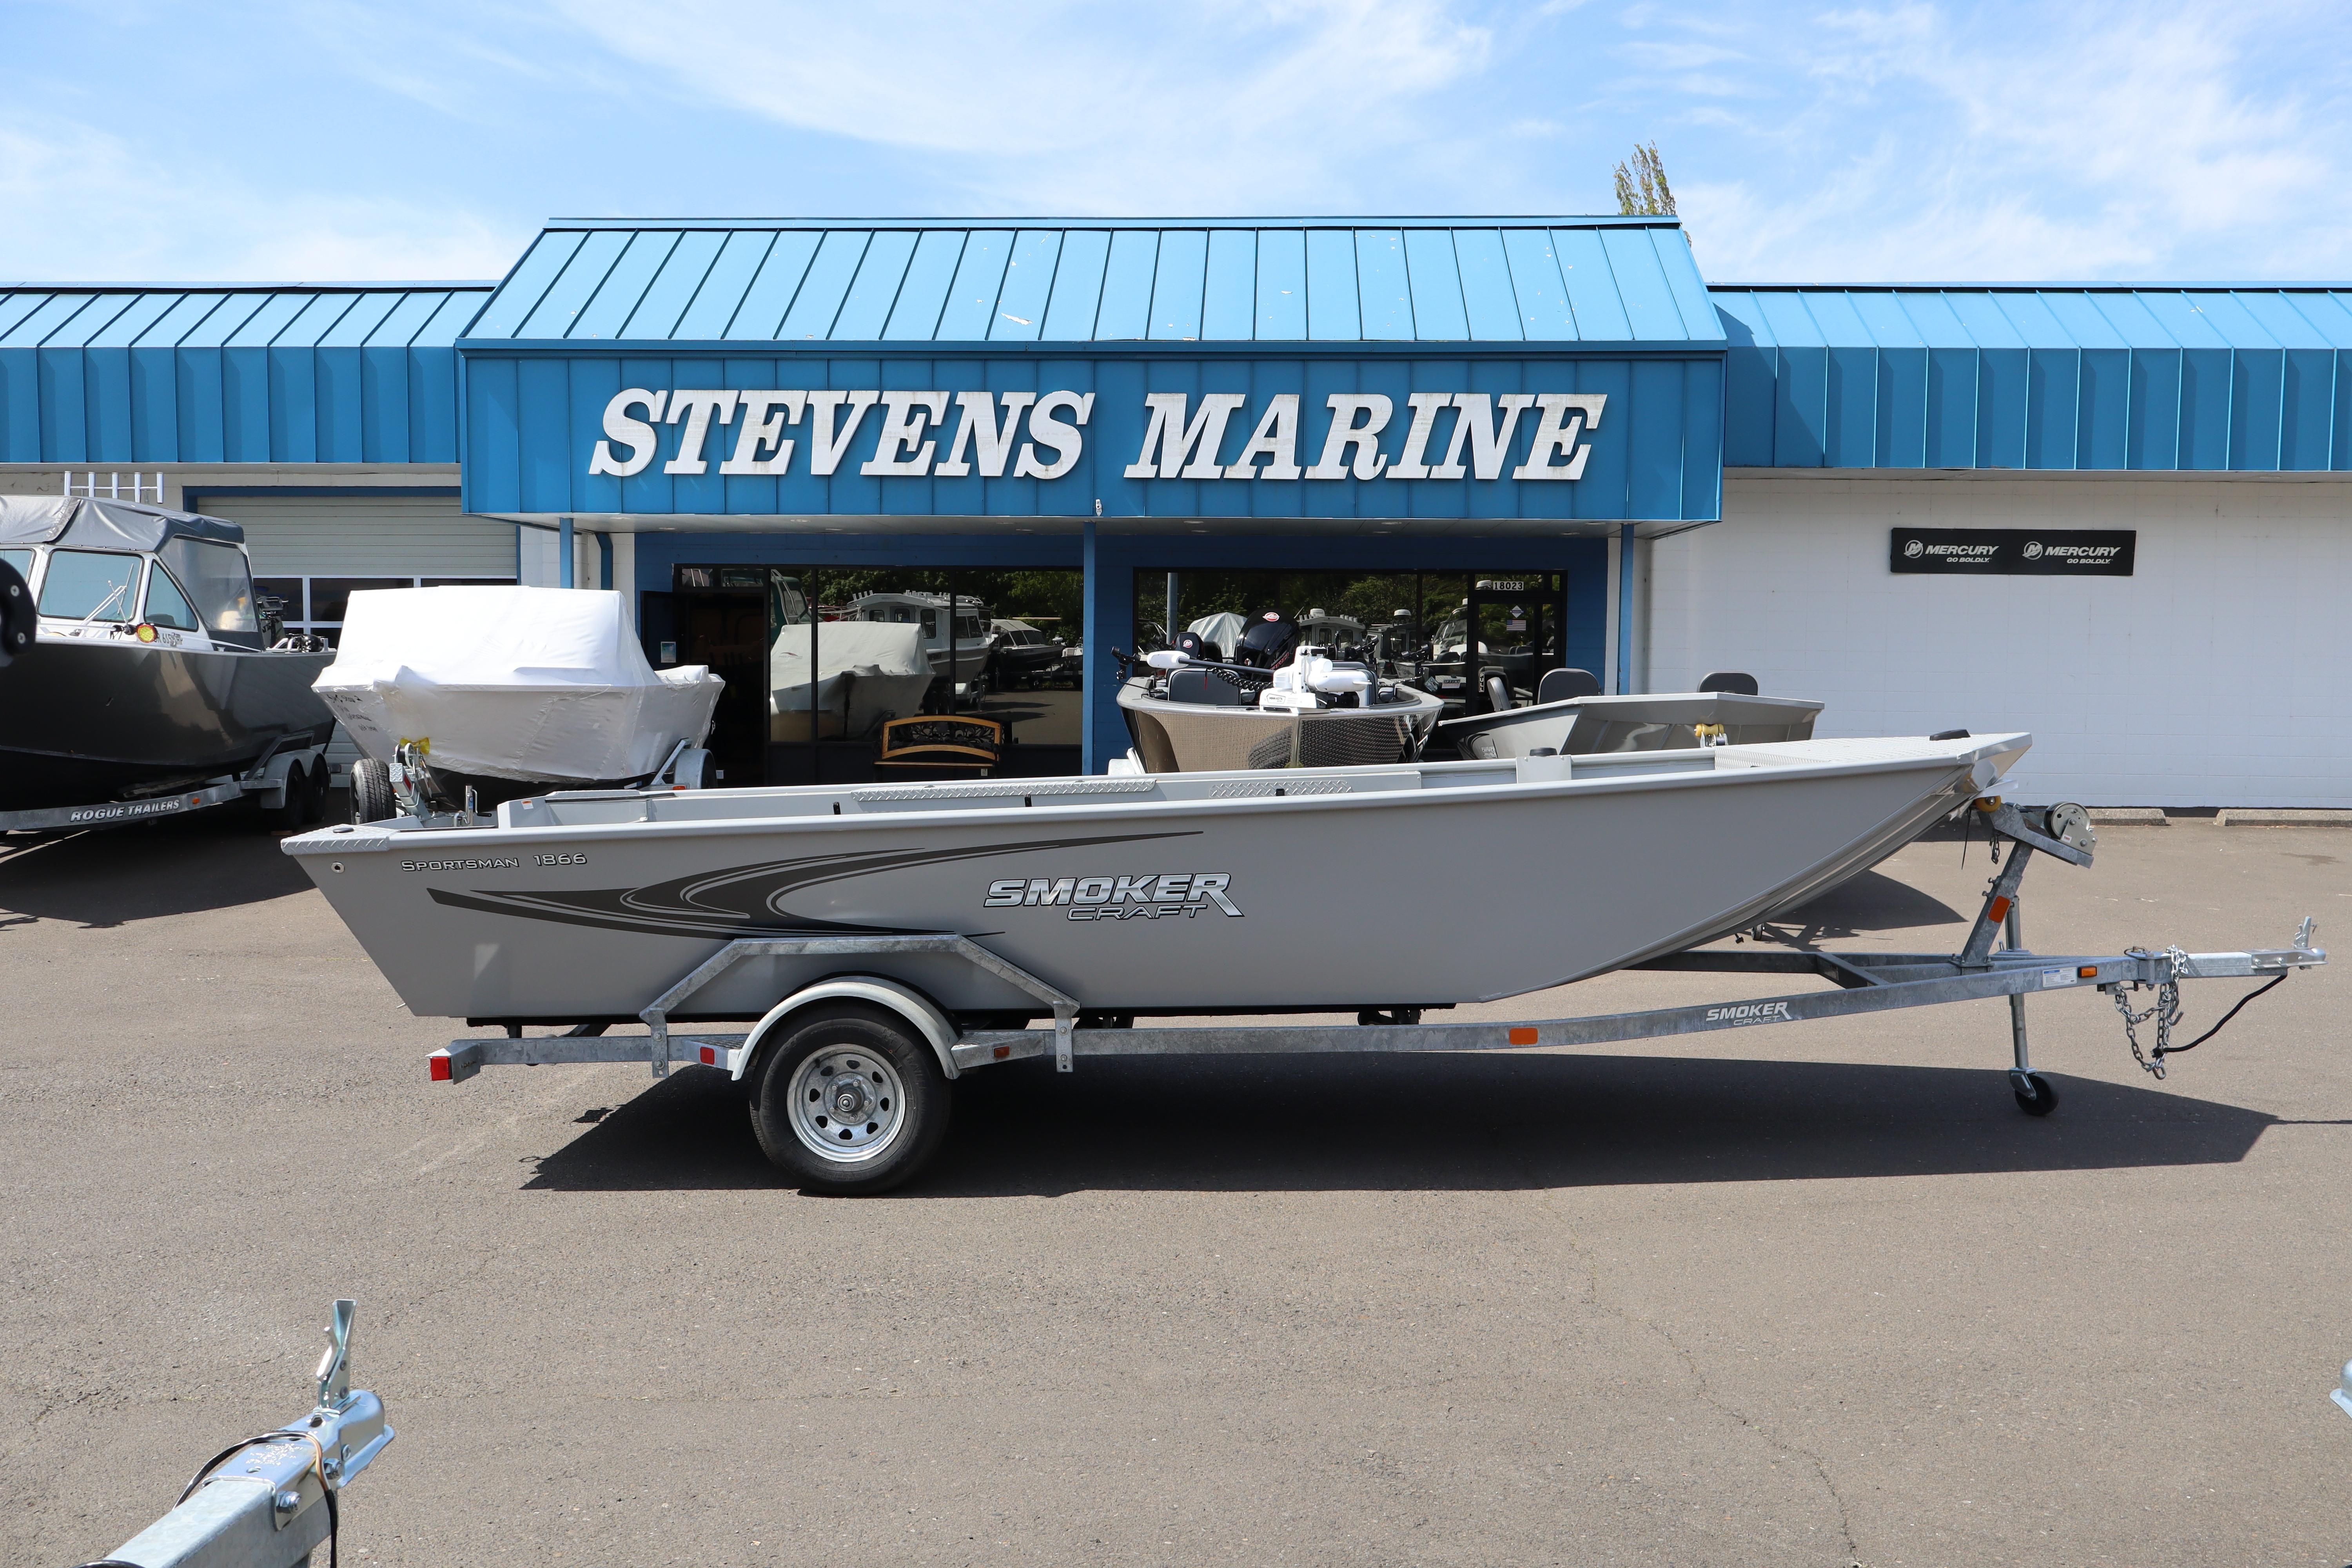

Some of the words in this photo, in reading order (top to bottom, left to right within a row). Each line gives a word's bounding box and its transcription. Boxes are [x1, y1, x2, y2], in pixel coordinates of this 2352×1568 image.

[589, 388, 1095, 479] STEVENS
[1123, 393, 1607, 480] MARINE
[1925, 545, 1999, 555] MERCURY
[2045, 546, 2121, 556] MERCURY
[1494, 582, 1523, 590] 18023
[70, 807, 125, 822] ROGUE
[128, 799, 180, 816] TRAILERS
[401, 858, 520, 871] SPORTSMAN
[533, 853, 587, 866] 1866
[983, 873, 1245, 917] SMOKER
[1067, 904, 1208, 921] CRAFT
[1706, 1002, 1792, 1021] SMOKER
[1733, 1015, 1780, 1025] CRAFT
